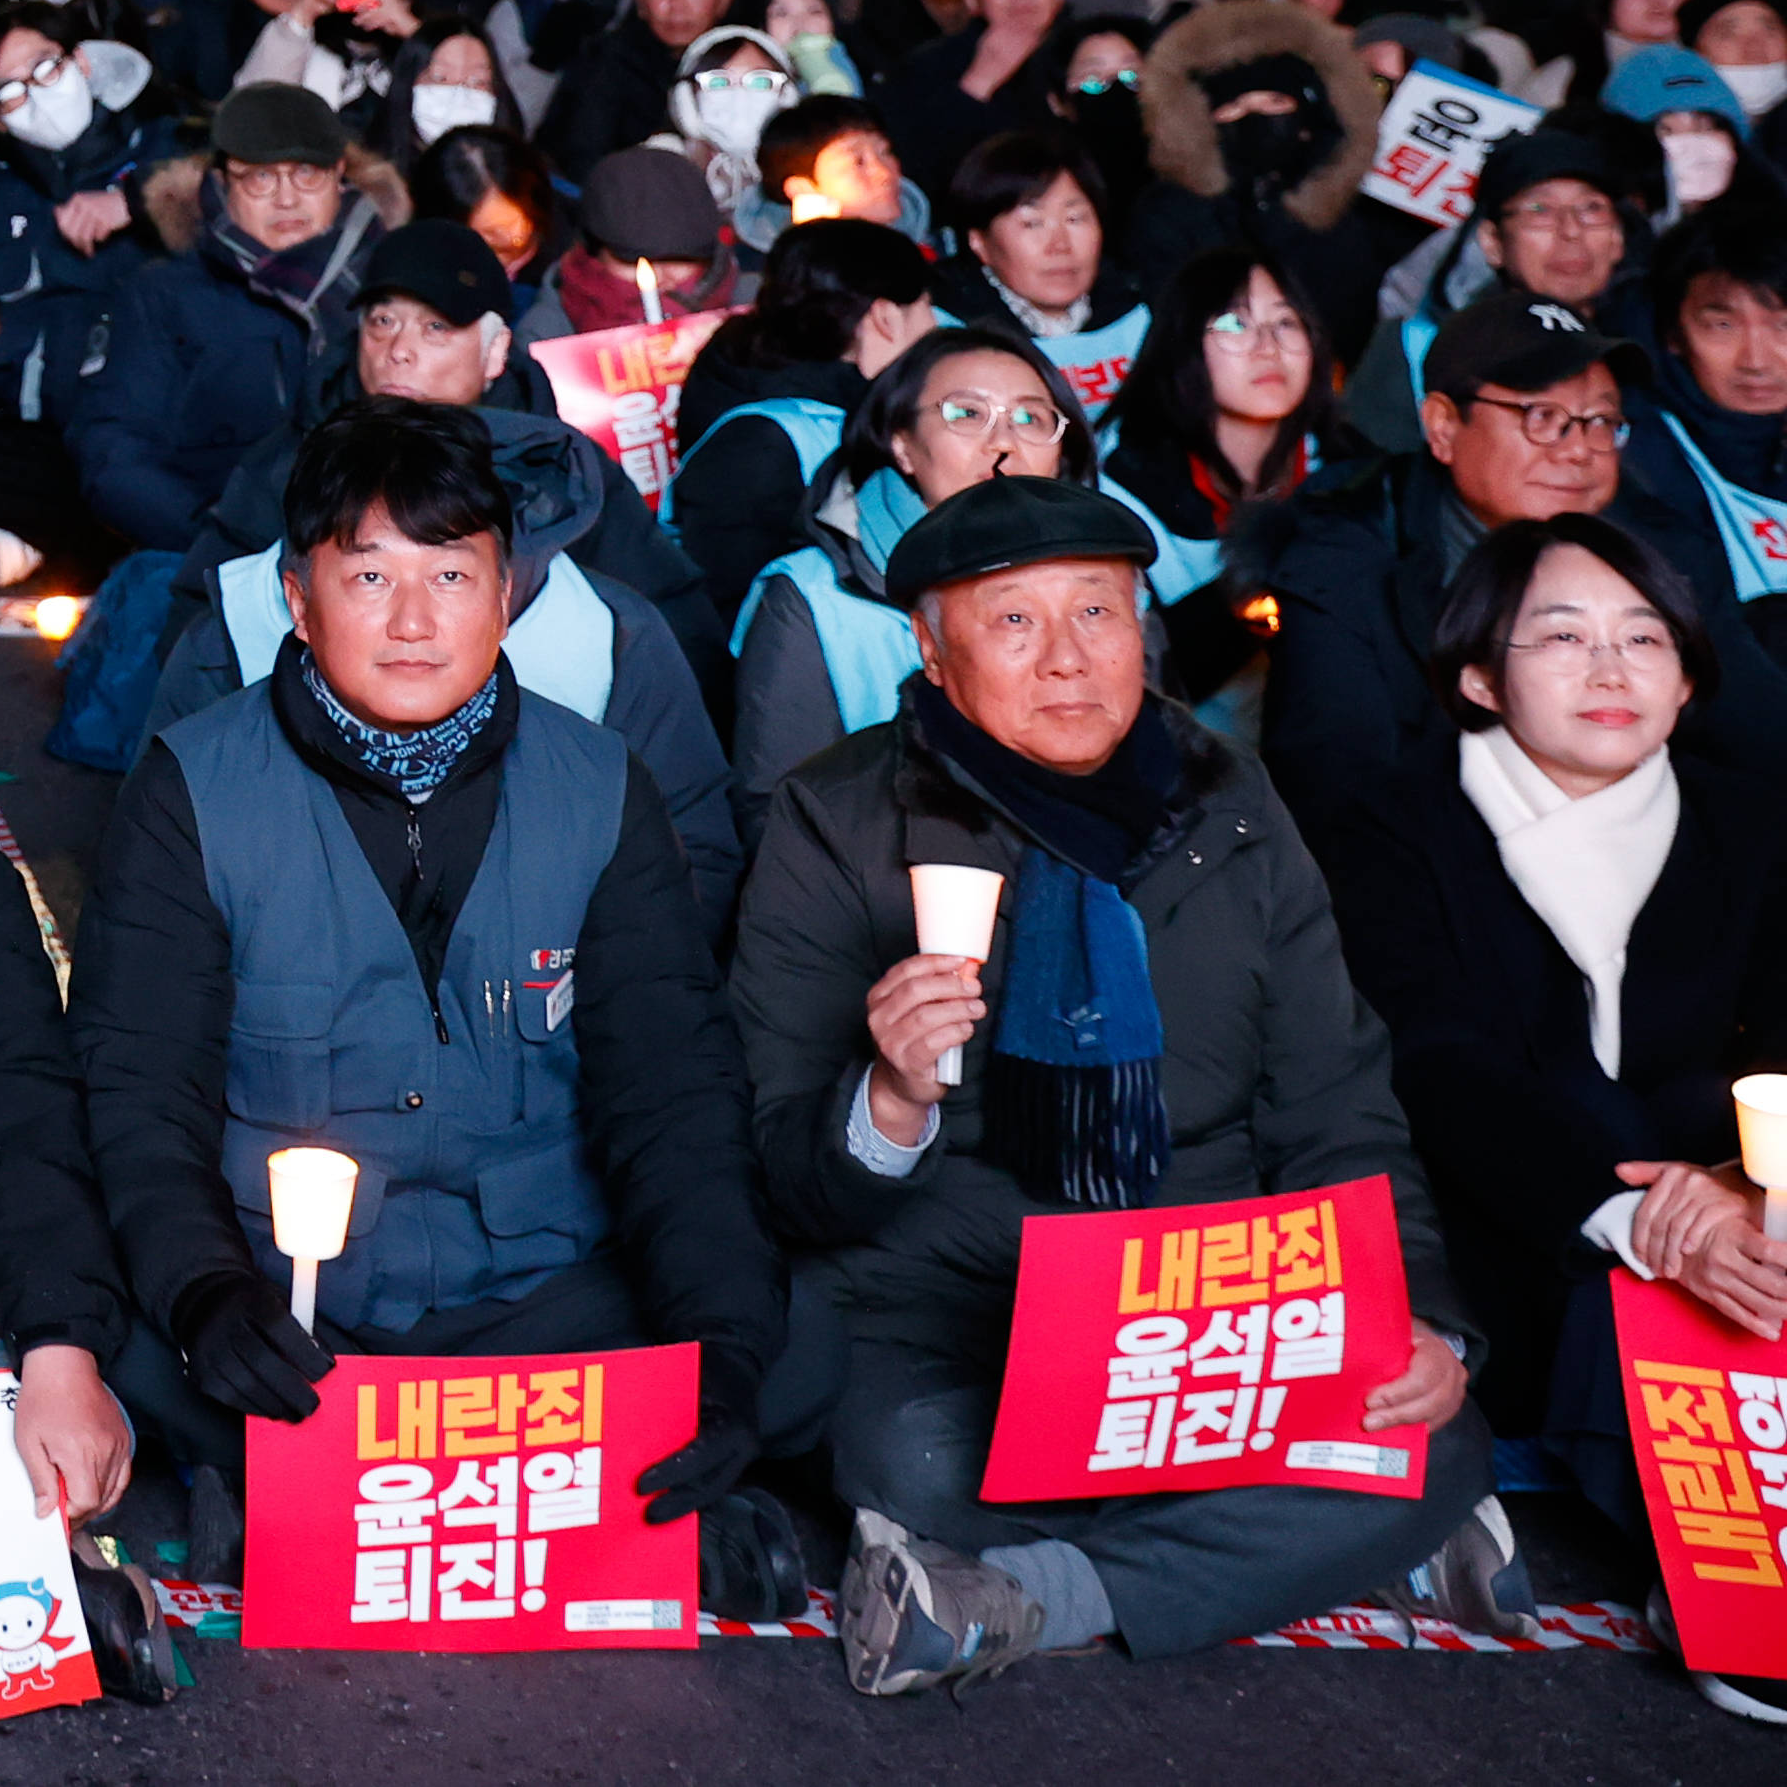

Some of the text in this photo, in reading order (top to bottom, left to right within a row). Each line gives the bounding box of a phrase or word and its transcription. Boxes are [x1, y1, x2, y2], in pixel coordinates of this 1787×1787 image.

[1117, 1199, 1343, 1315] 내란죄
[1106, 1291, 1347, 1400] 윤석열
[356, 1364, 604, 1461] 내란죄
[1087, 1386, 1289, 1473] 퇴진!
[353, 1446, 603, 1548] 윤석열
[1633, 1359, 1784, 1587] 내란죄
[350, 1537, 548, 1623] 퇴진!
